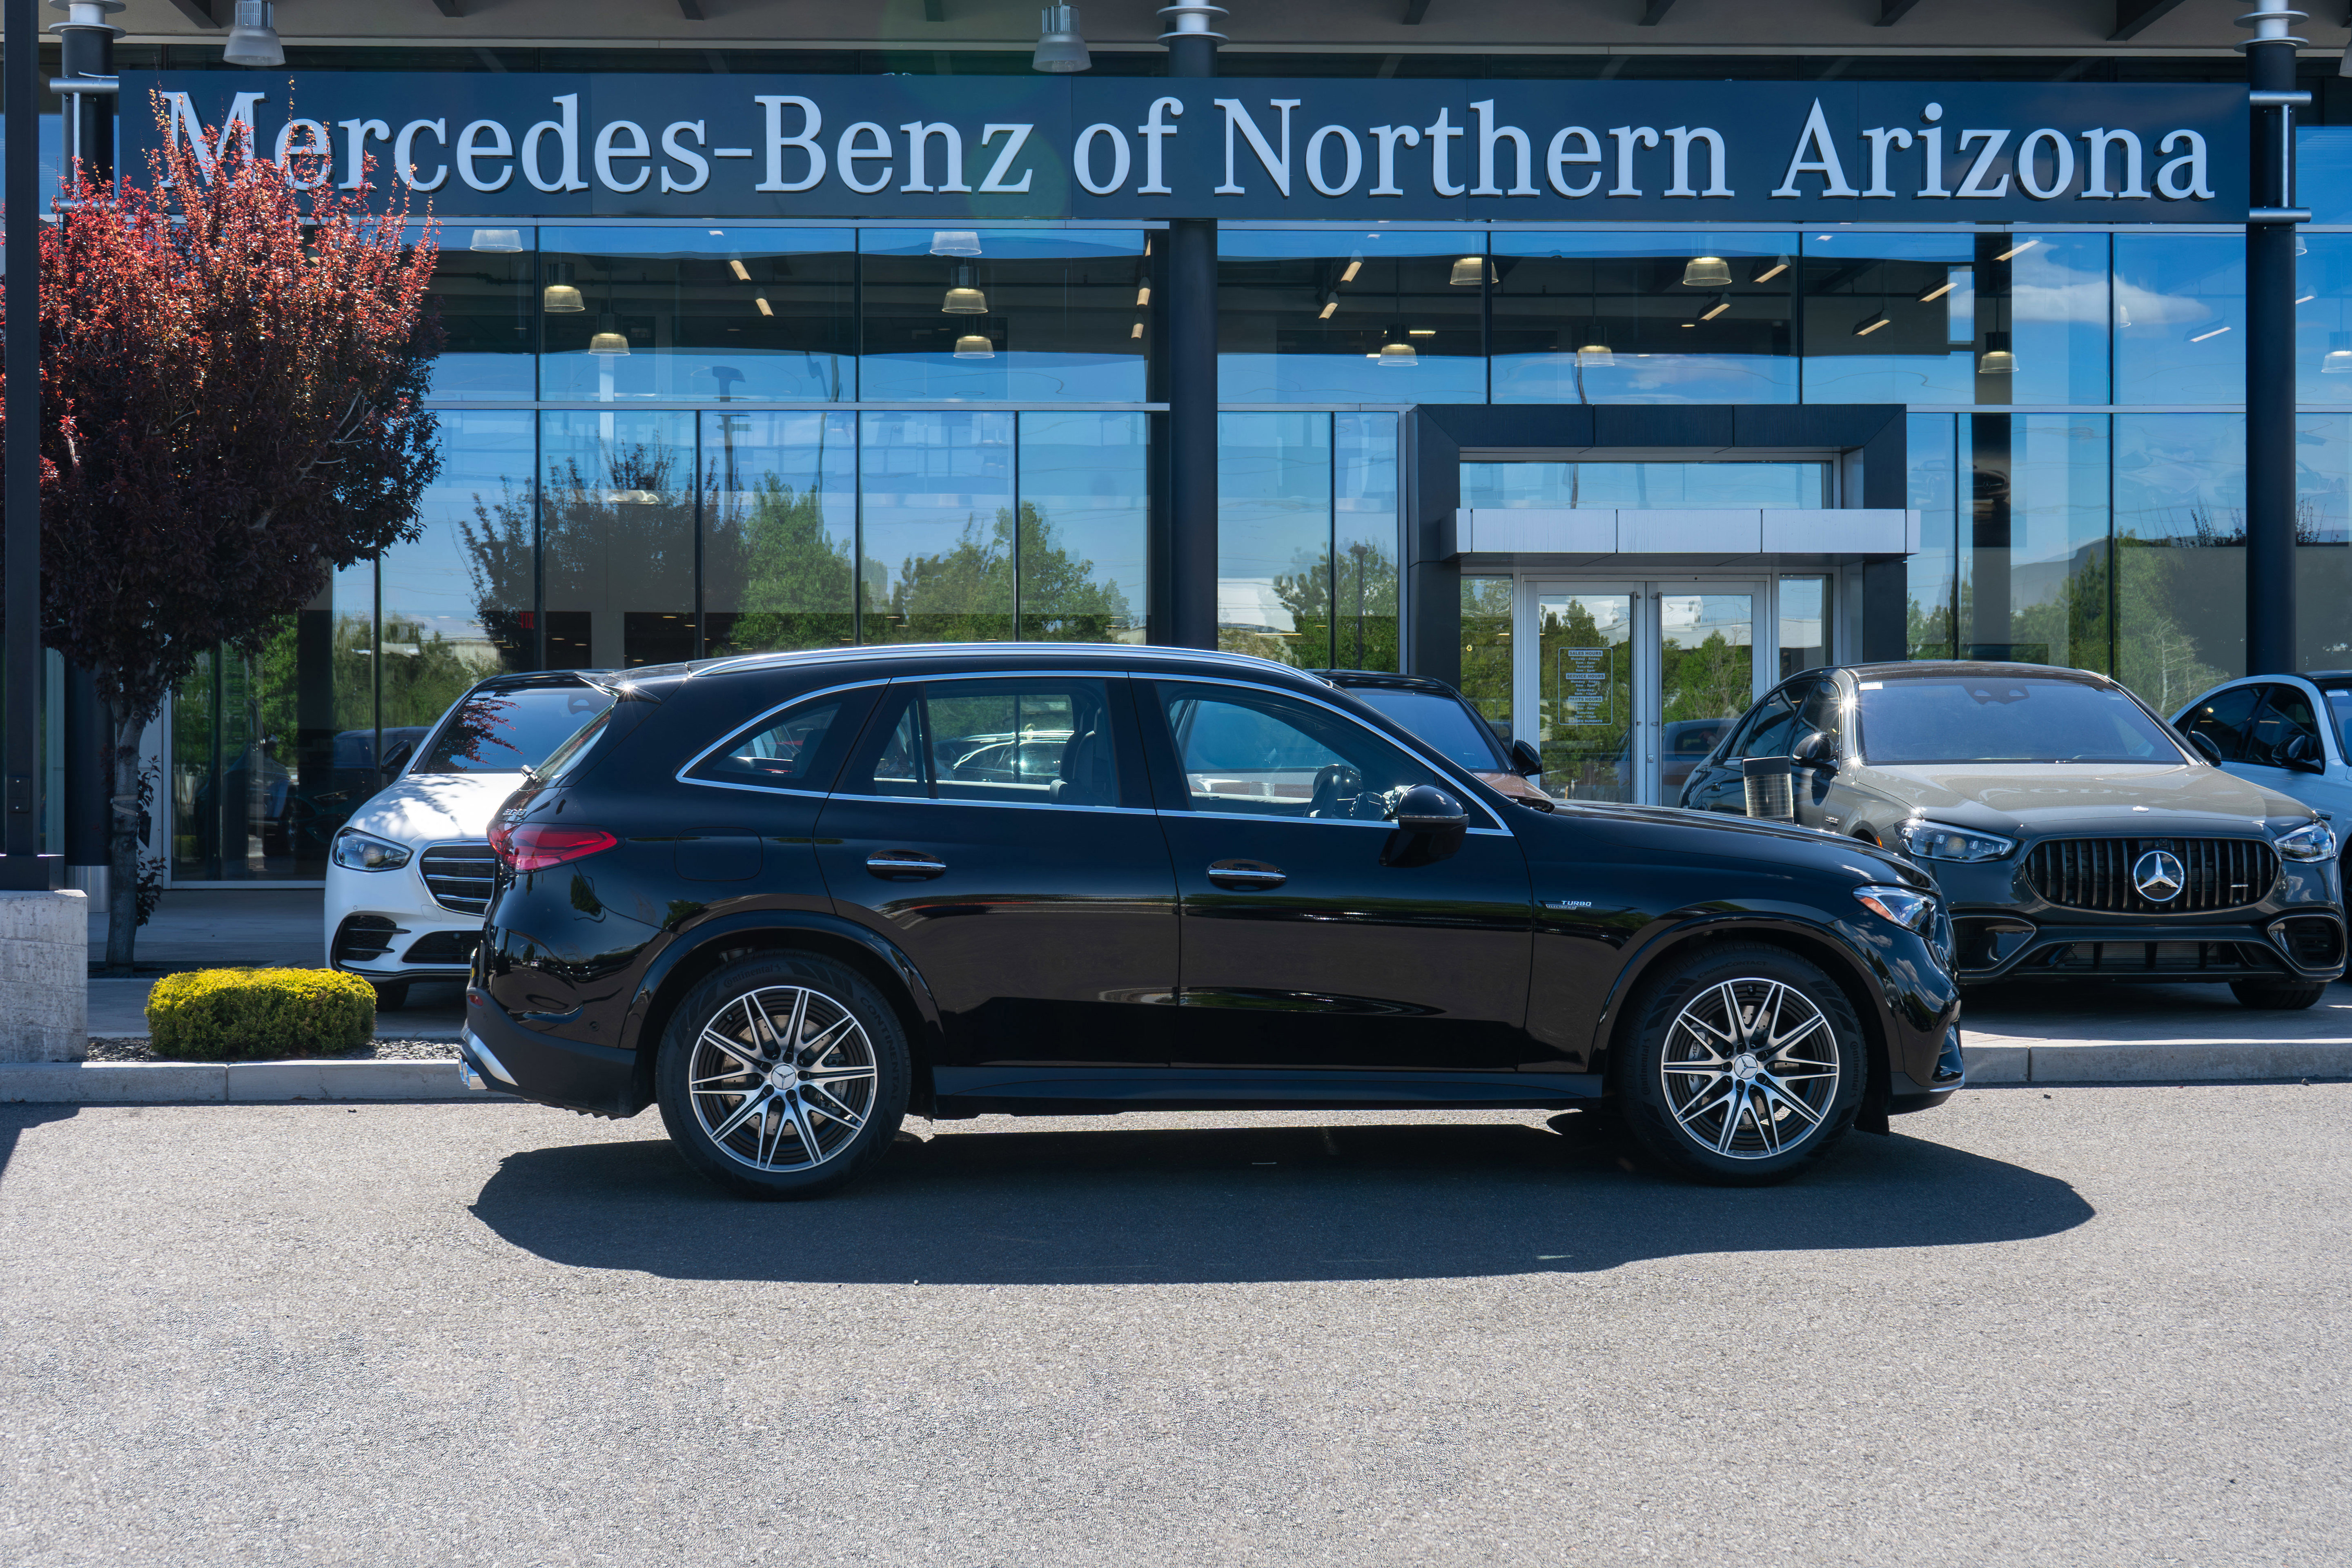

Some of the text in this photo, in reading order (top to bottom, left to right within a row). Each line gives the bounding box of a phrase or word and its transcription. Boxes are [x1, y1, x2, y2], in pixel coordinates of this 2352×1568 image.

[158, 91, 2216, 200] Mercedes-Benz of Northern Arizona
[723, 964, 774, 988] Continental
[860, 997, 899, 1105] CONTINENTAL
[1639, 1045, 1651, 1095] Continental
